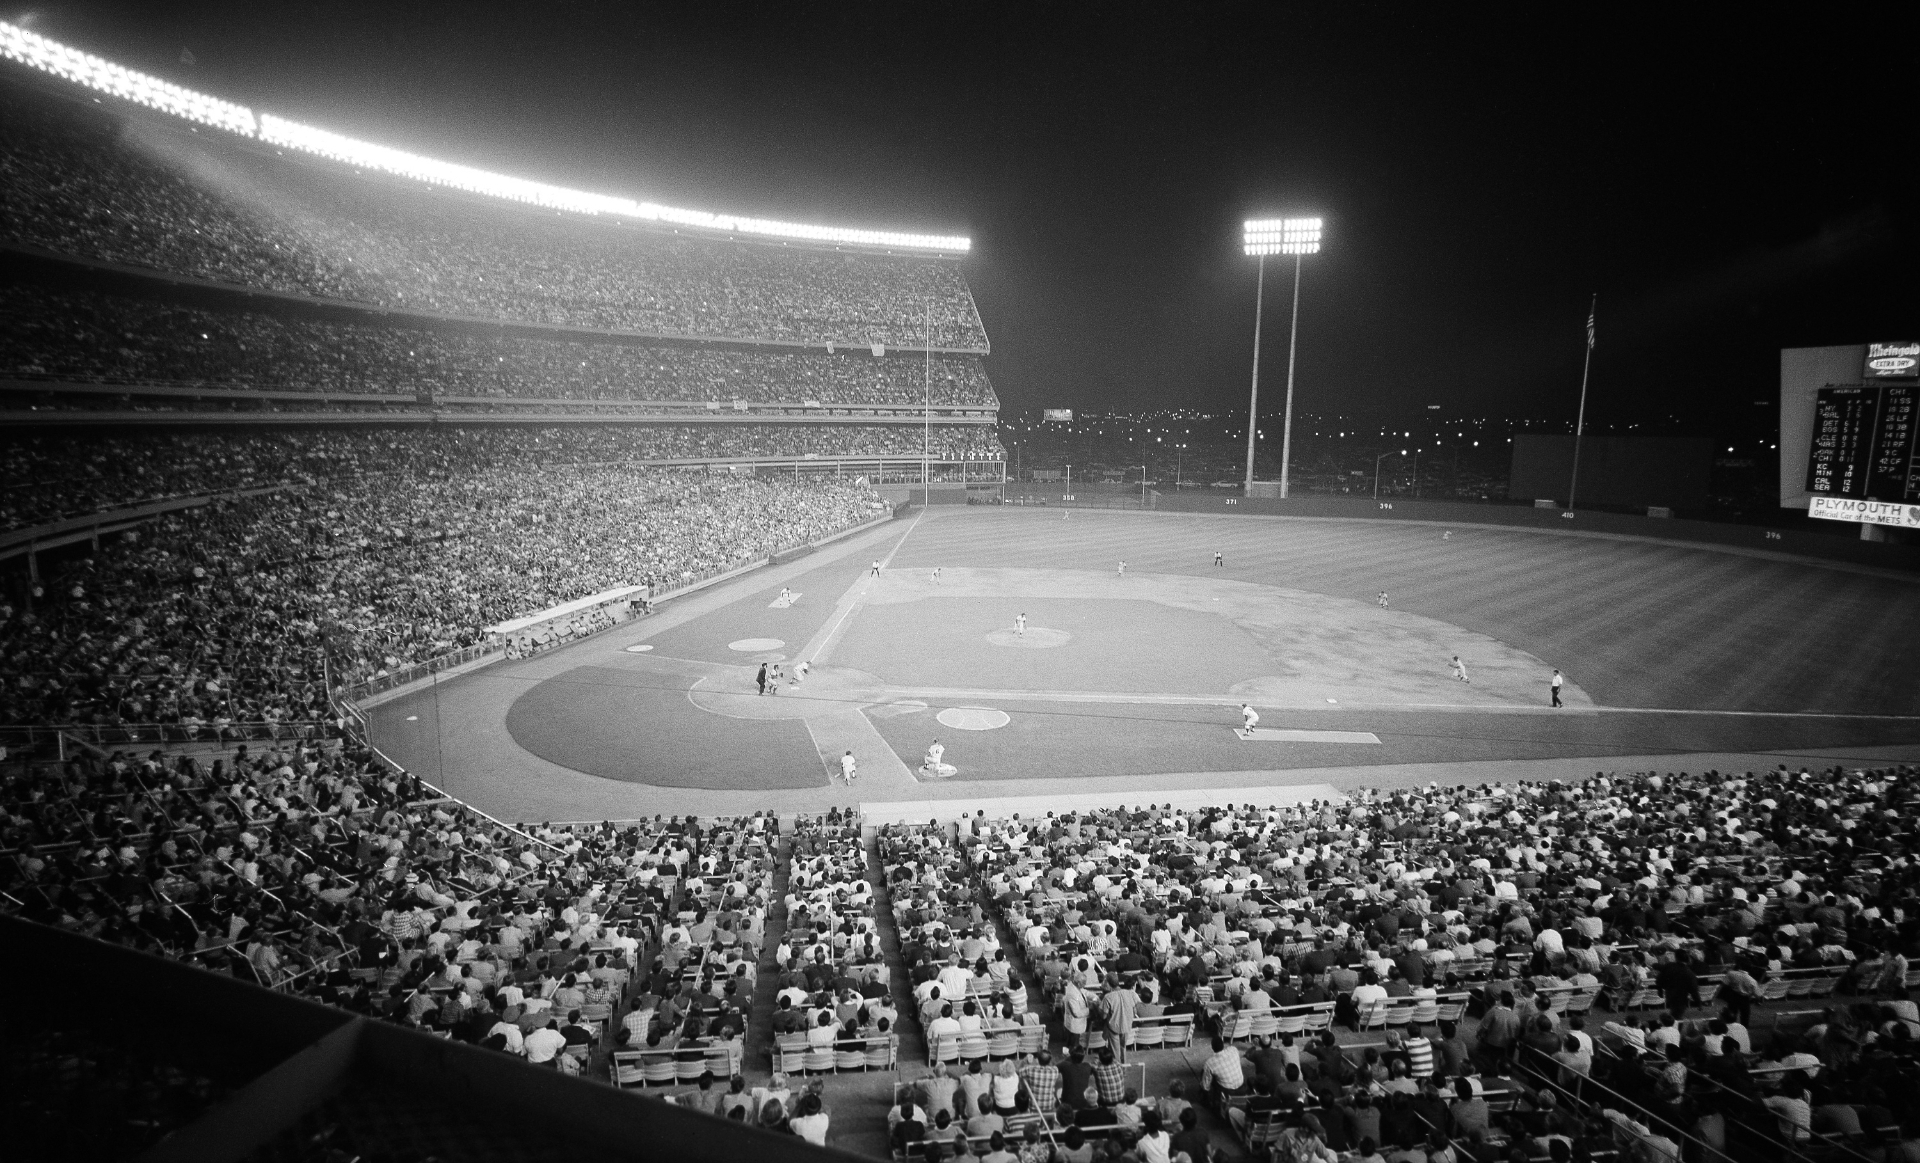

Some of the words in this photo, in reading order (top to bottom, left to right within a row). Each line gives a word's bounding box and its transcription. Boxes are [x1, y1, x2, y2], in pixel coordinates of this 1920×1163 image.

[1869, 342, 1920, 357] Rheingold
[1816, 499, 1902, 516] PLYMOUTH
[1814, 509, 1838, 518] Official
[1864, 514, 1876, 522] the
[1878, 515, 1900, 524] METS
[1766, 532, 1781, 540] 396
